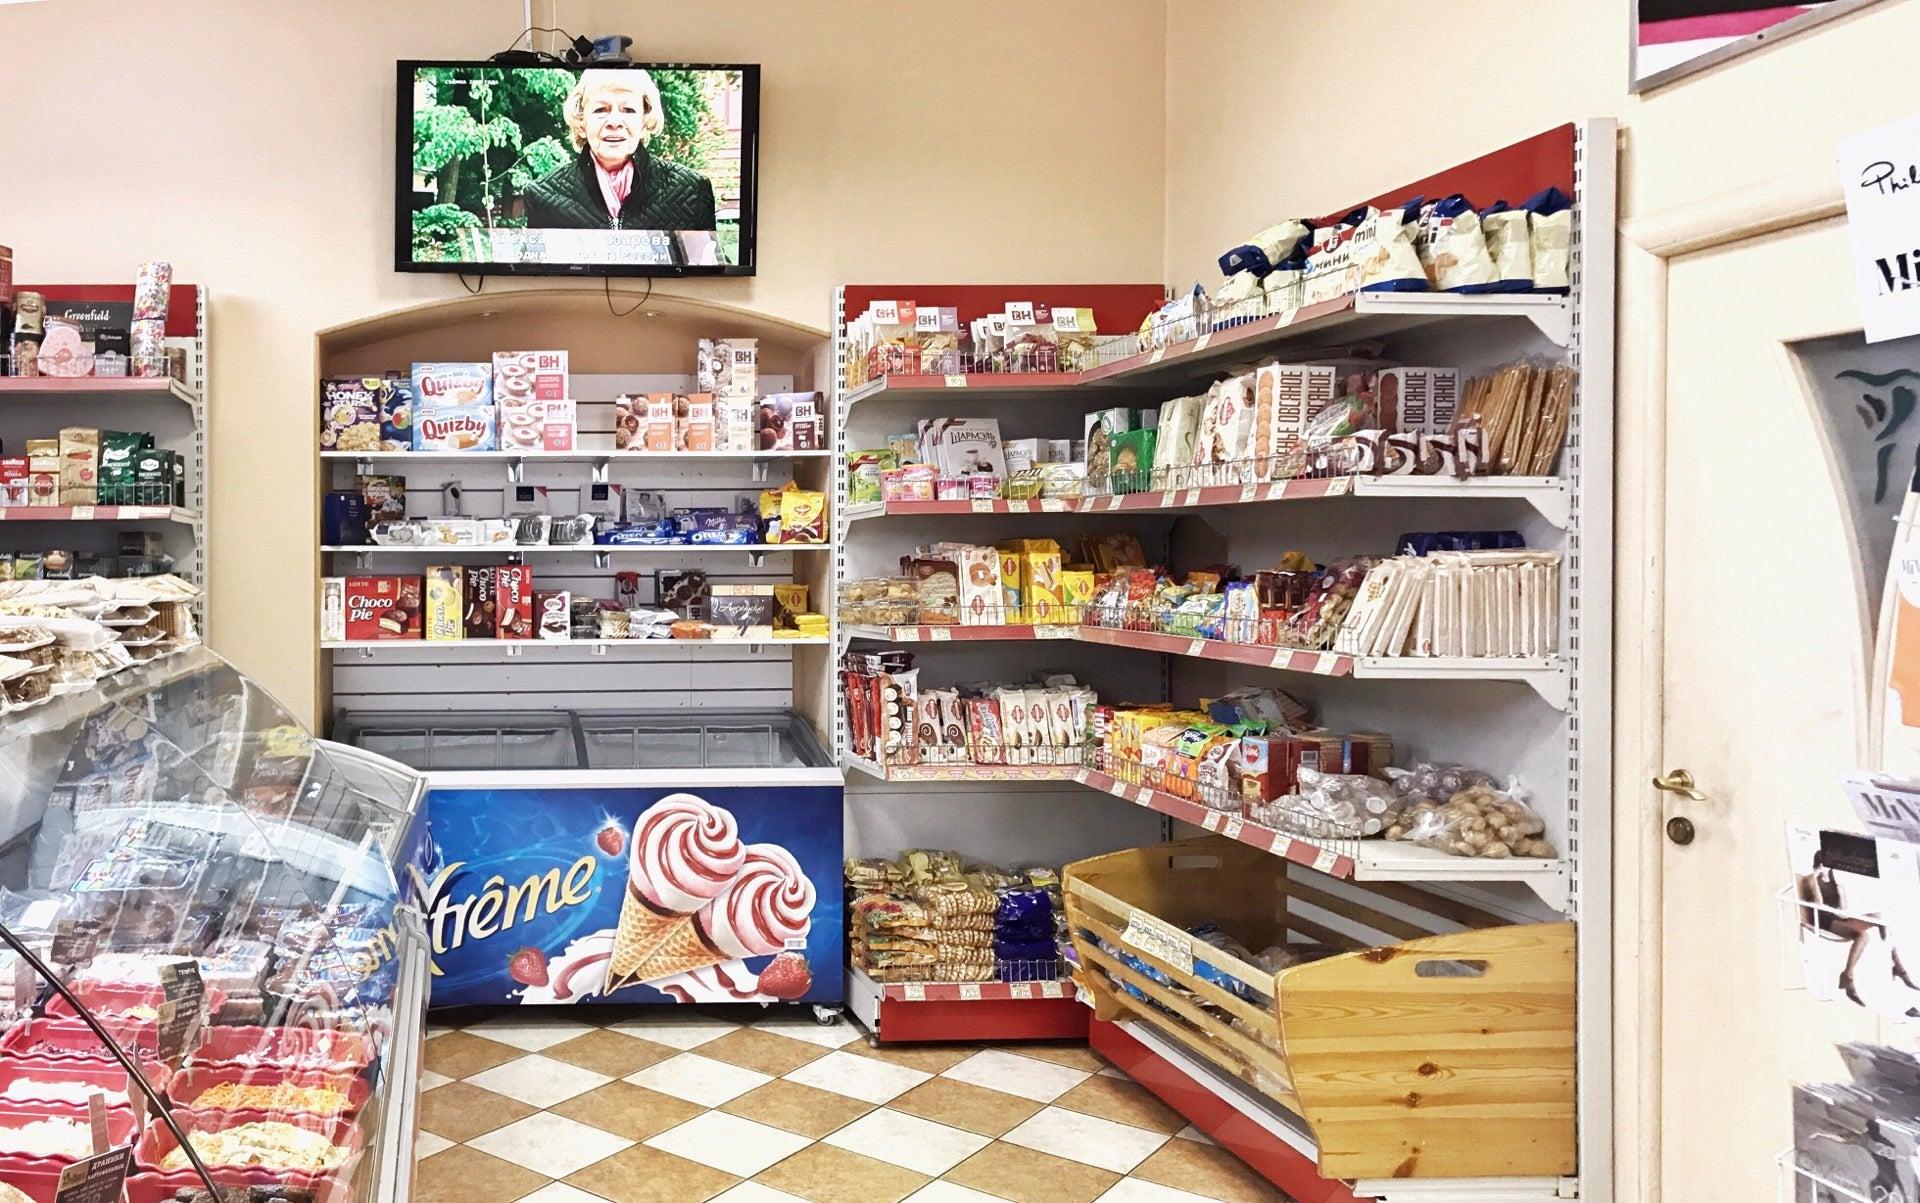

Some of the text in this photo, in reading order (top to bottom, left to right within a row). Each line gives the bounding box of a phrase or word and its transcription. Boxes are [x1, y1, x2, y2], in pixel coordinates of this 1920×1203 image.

[64, 308, 111, 321] Greenfield
[918, 315, 937, 326] BH
[539, 356, 559, 368] BH
[735, 351, 752, 362] BH
[1278, 370, 1303, 423] ОВСЯНОЕ
[1403, 372, 1427, 424] ОВСЯНОЕ
[796, 405, 811, 417] BH
[422, 416, 487, 440] Quizby
[478, 568, 490, 602] Choco
[510, 568, 521, 603] Choco
[348, 595, 393, 609] Choco
